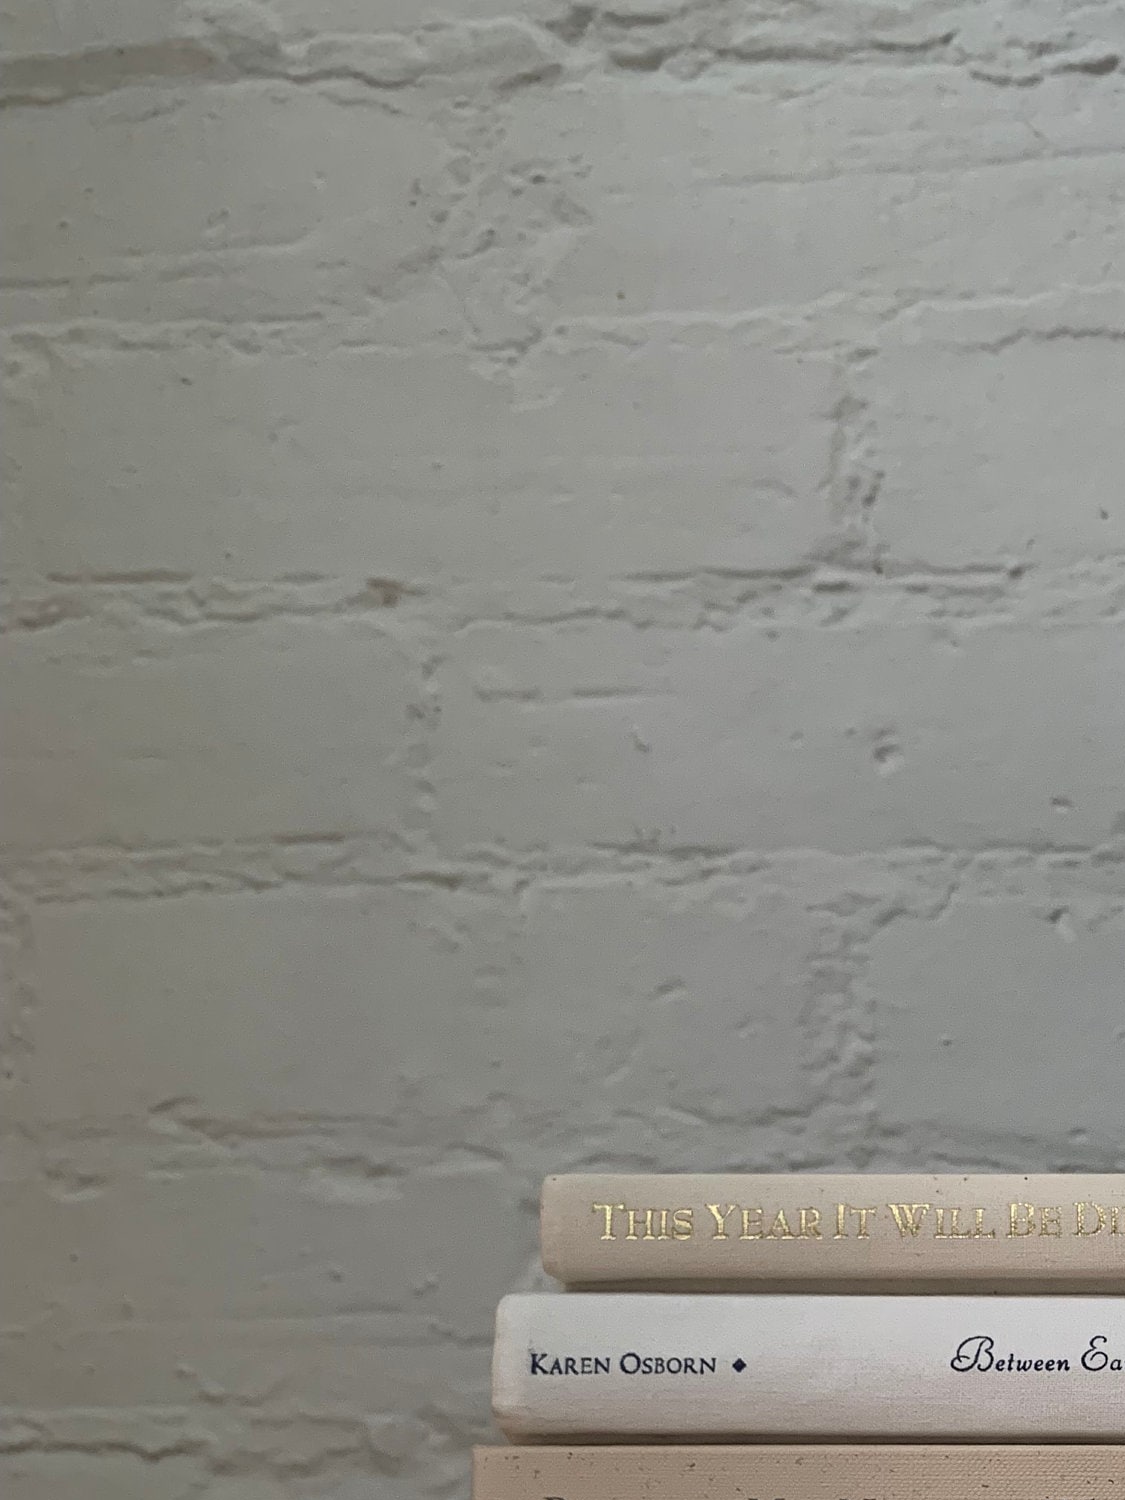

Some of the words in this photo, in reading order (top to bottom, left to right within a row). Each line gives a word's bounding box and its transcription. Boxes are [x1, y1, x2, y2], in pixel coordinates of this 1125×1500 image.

[592, 1202, 694, 1241] THIS
[705, 1202, 823, 1241] YEAR
[832, 1202, 878, 1241] IT
[887, 1202, 996, 1240] WILL
[1005, 1201, 1062, 1239] BE
[530, 1353, 611, 1375] KAREN
[619, 1352, 717, 1376] OSBORN
[950, 1335, 1070, 1374] Between
